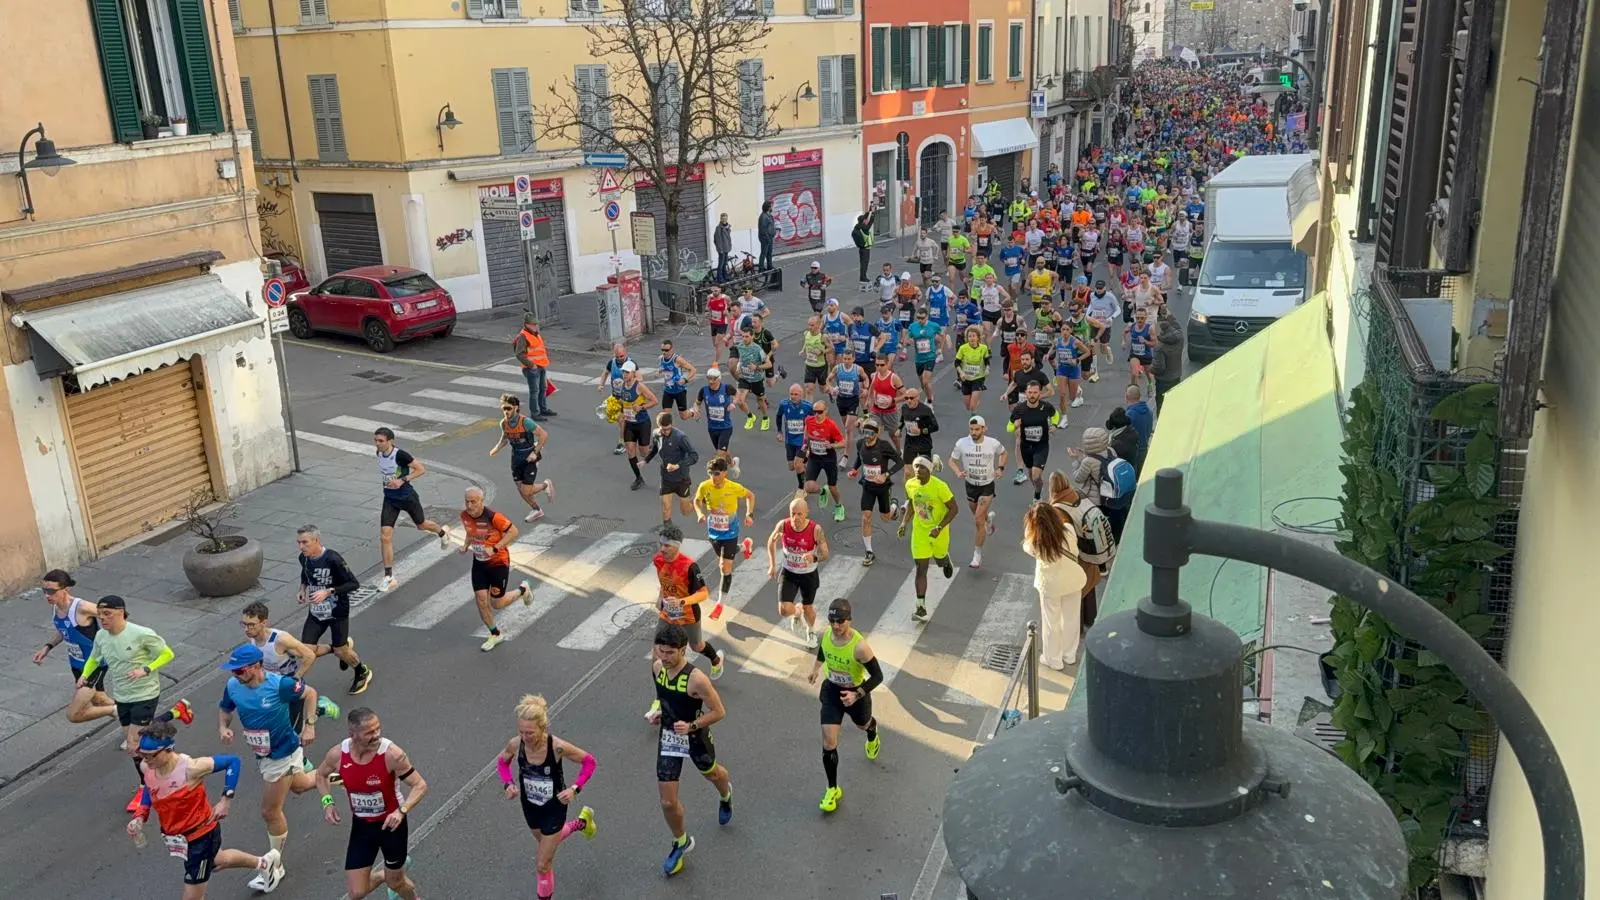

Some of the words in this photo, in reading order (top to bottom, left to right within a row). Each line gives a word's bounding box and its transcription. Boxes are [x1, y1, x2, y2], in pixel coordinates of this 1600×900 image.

[764, 155, 785, 167] WOW
[313, 567, 331, 578] 20
[656, 667, 689, 693] ALE
[249, 735, 263, 745] 113
[528, 783, 548, 795] 2146
[357, 798, 379, 807] 2102
